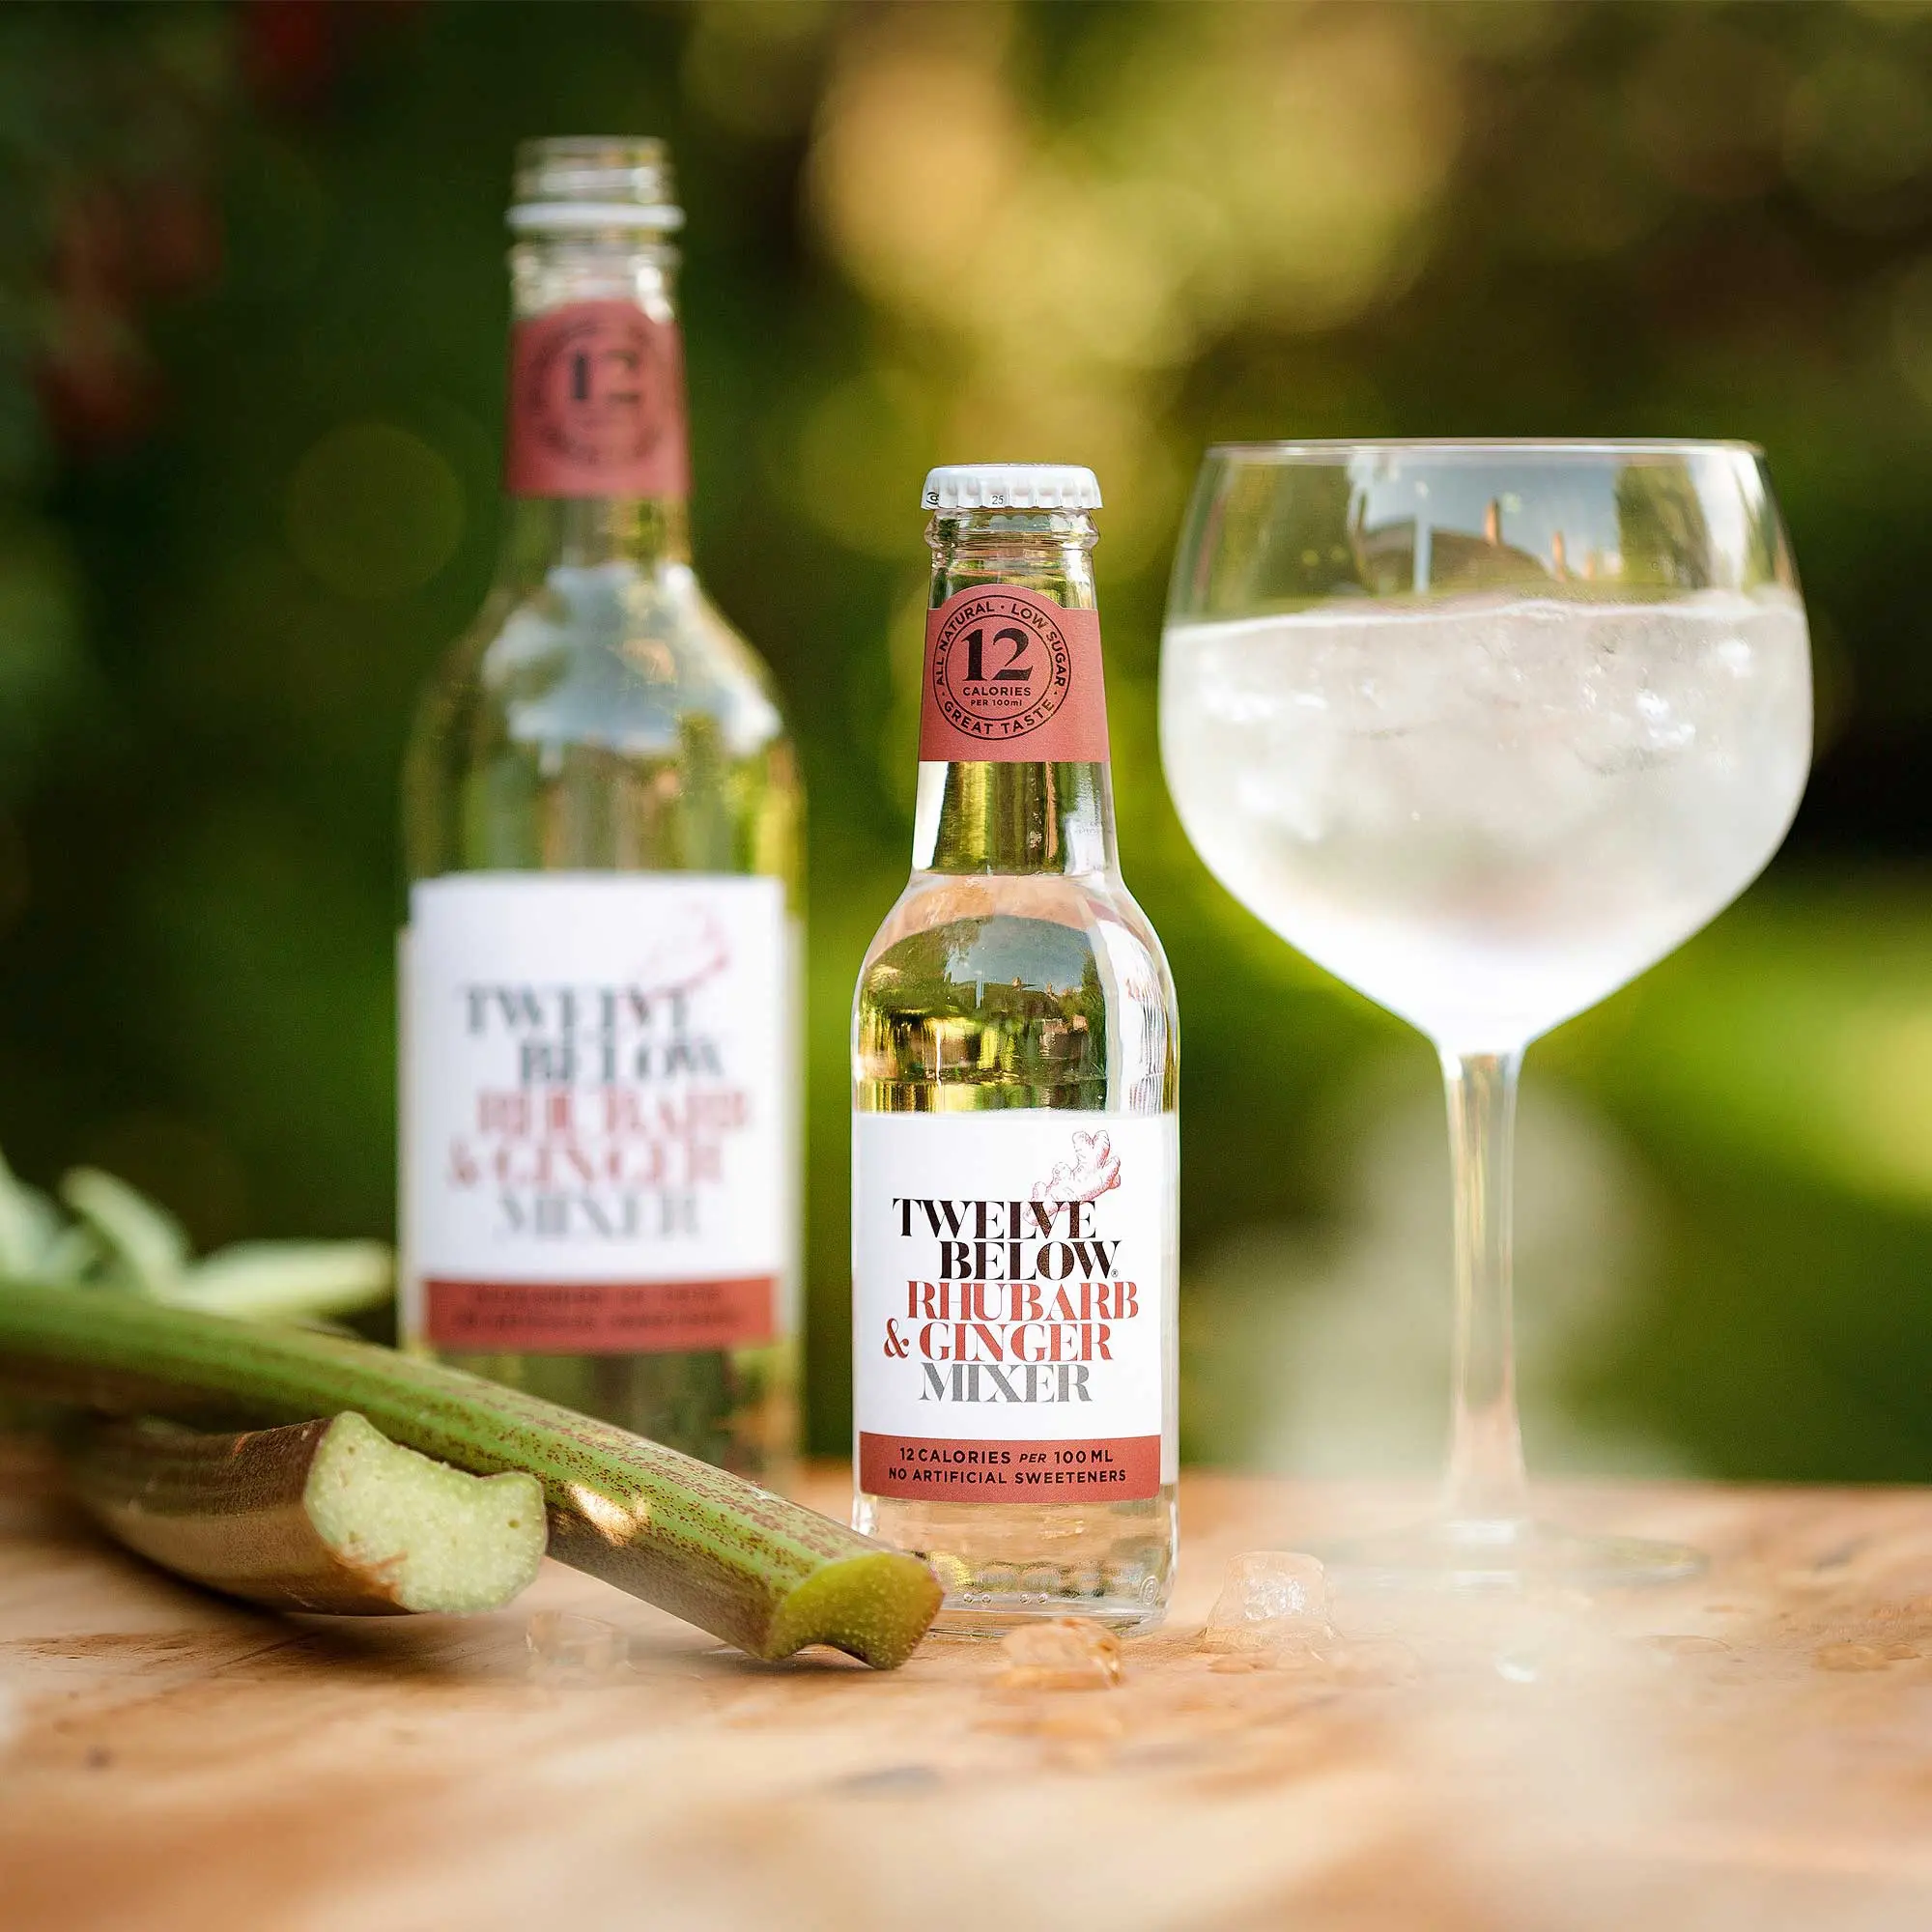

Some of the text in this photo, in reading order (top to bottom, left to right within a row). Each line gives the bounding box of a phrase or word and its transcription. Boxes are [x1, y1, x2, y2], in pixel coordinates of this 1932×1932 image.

[991, 495, 1004, 505] 25
[935, 601, 1067, 687] ALL NATURAL LOW SUGAR
[960, 627, 1034, 682] 12
[962, 686, 1032, 696] CALORIES
[944, 698, 1055, 735] GREAT TASTE
[892, 1197, 1096, 1239] TWELVE
[939, 1240, 1122, 1280] BELOW
[906, 1280, 1139, 1321] RHUBARB
[883, 1319, 1114, 1362] & GINGER
[919, 1362, 1093, 1404] MIXER
[889, 1467, 1126, 1485] NO ARTIFICIAL SWEETENERS
[1018, 1453, 1047, 1463] PER
